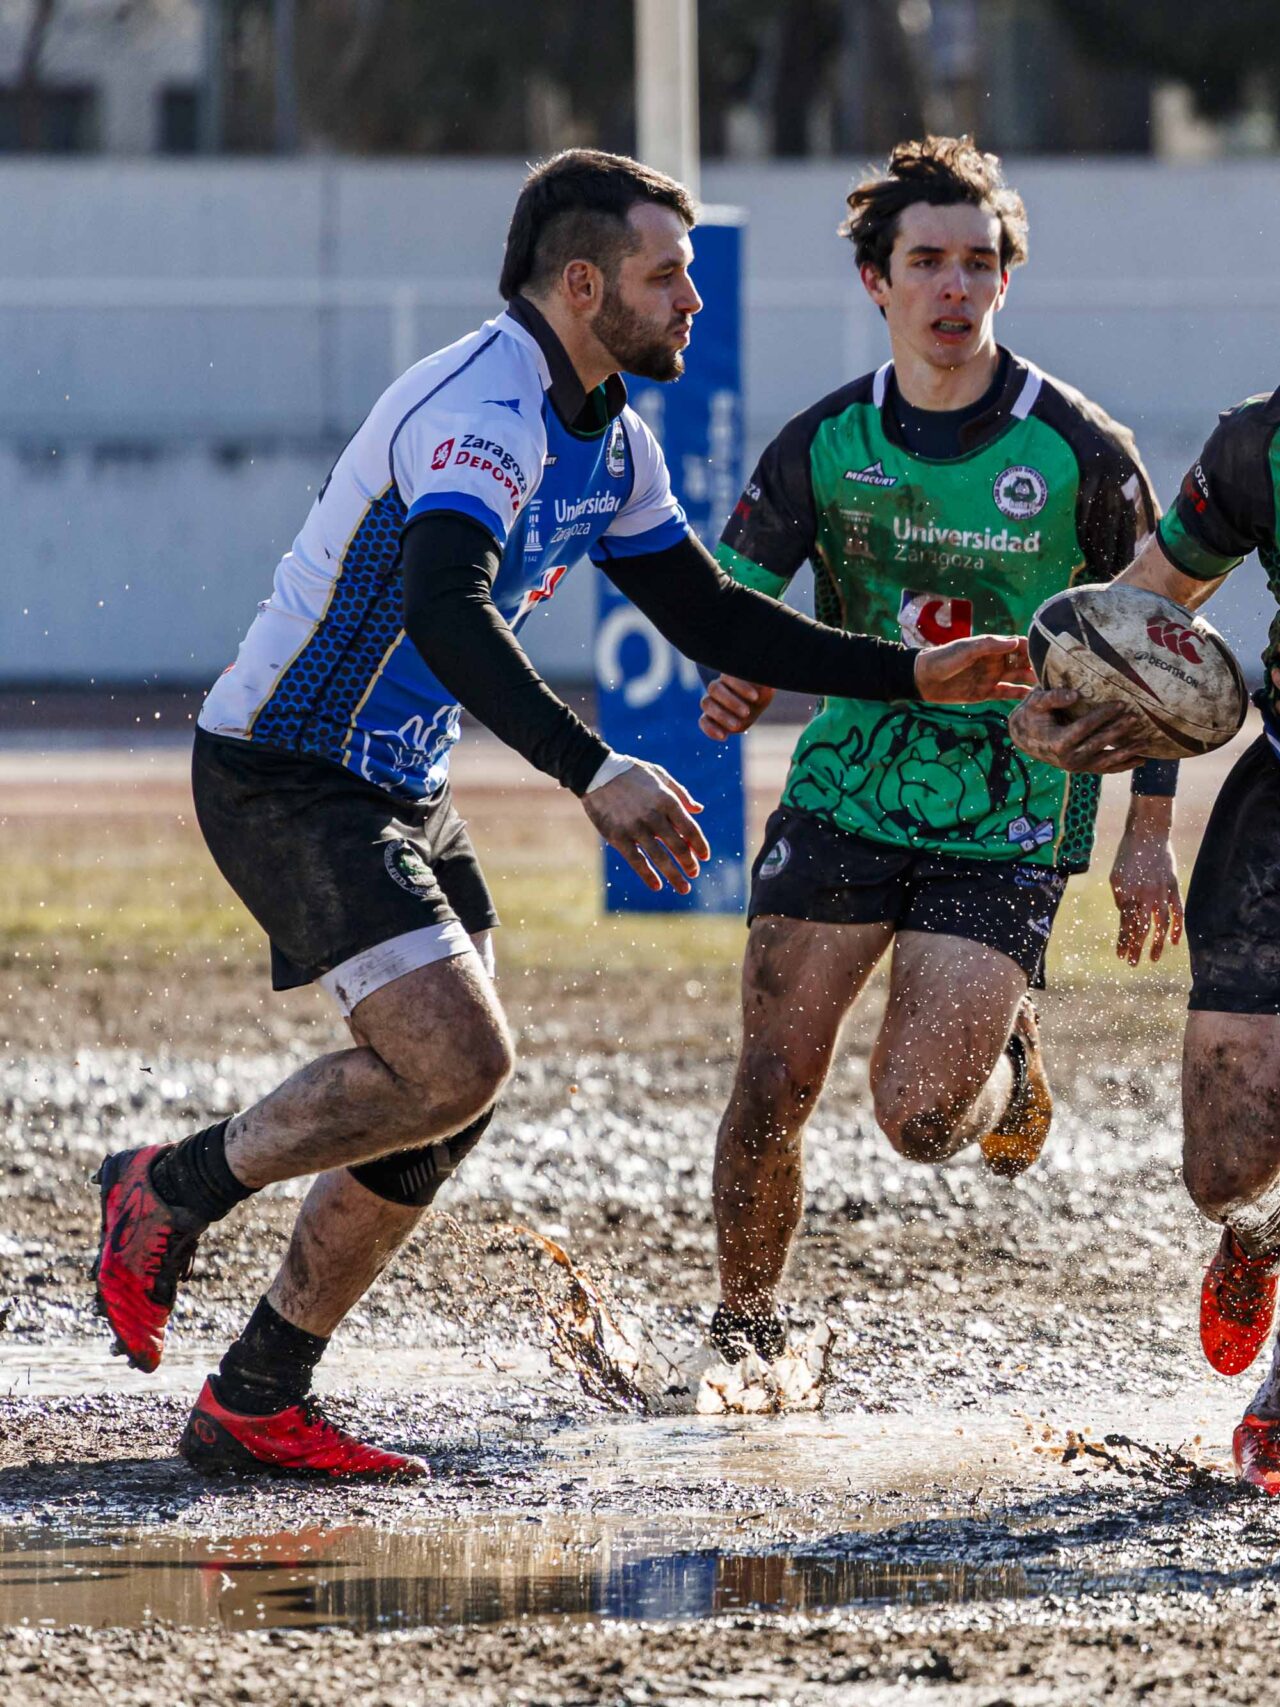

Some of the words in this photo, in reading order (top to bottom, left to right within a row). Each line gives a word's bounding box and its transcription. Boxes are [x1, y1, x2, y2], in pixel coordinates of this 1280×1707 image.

[460, 434, 527, 494] Zaragoza
[845, 471, 897, 486] MERCURY
[893, 517, 1040, 553] Universidad
[894, 544, 984, 571] Zaragoza
[1148, 656, 1199, 688] DECATHLON
